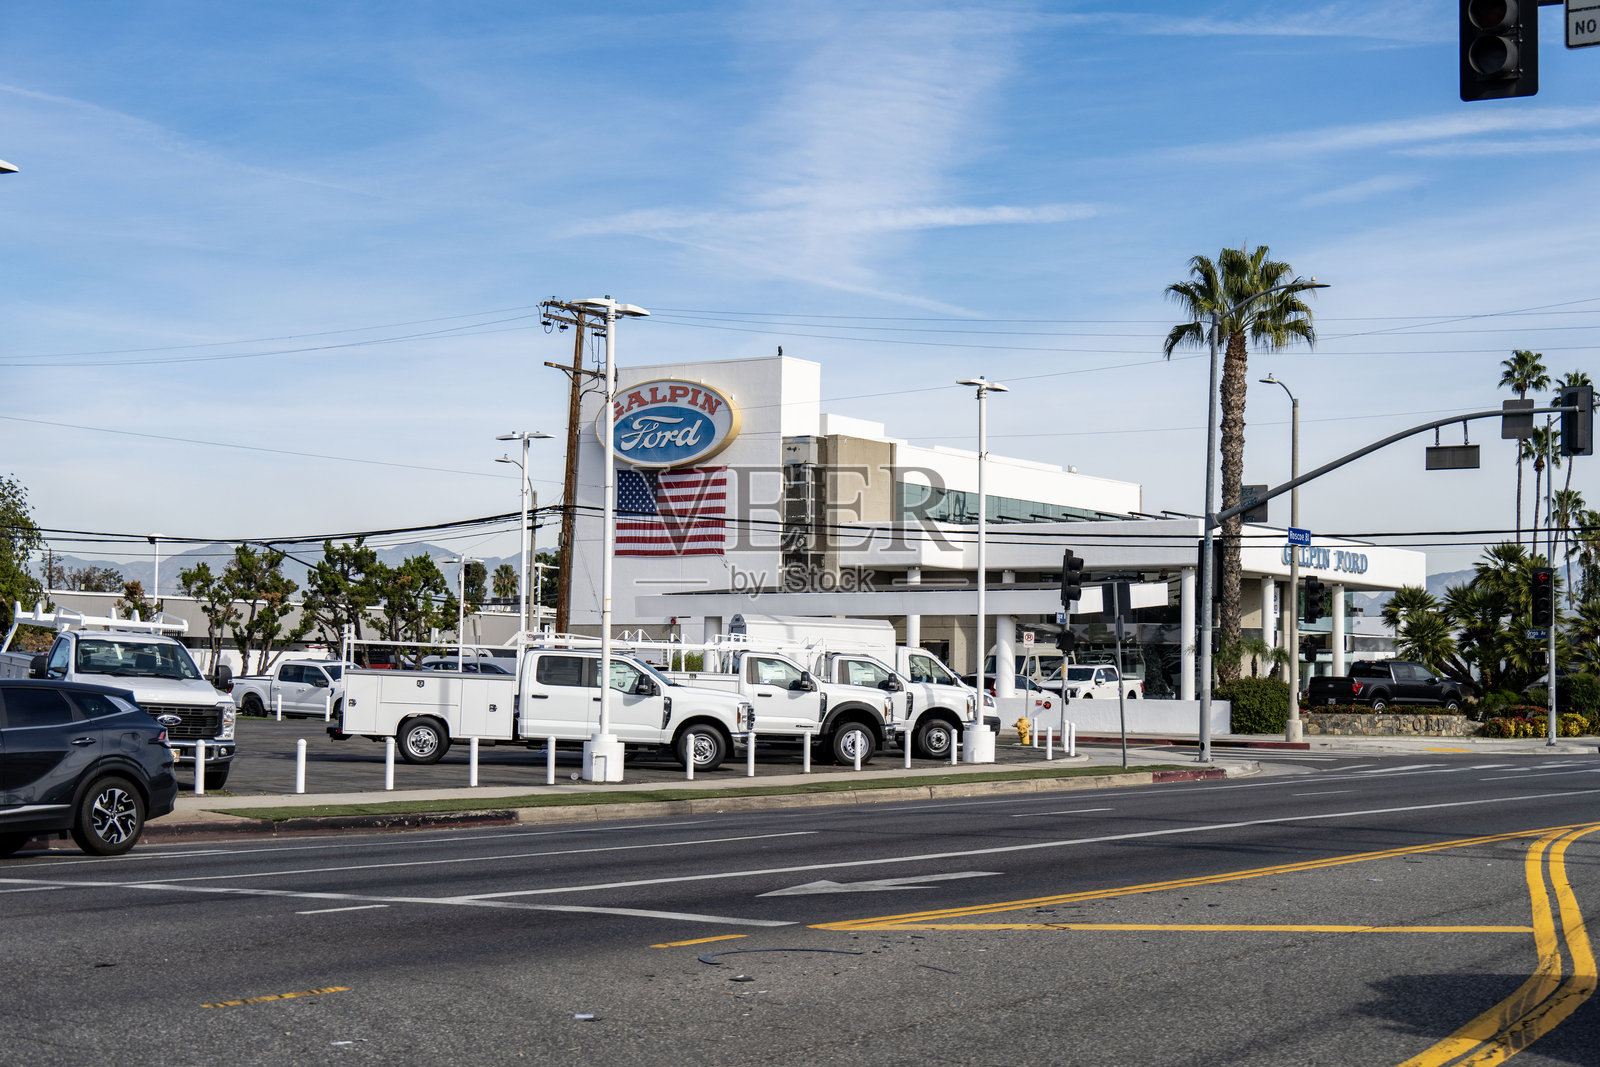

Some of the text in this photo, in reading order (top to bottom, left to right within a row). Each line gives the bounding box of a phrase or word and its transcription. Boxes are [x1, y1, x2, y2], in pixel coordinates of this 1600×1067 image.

[1575, 19, 1597, 35] NO
[620, 415, 703, 451] Ford
[1289, 530, 1305, 541] Roscoe
[1282, 543, 1368, 573] GLPIN FORD
